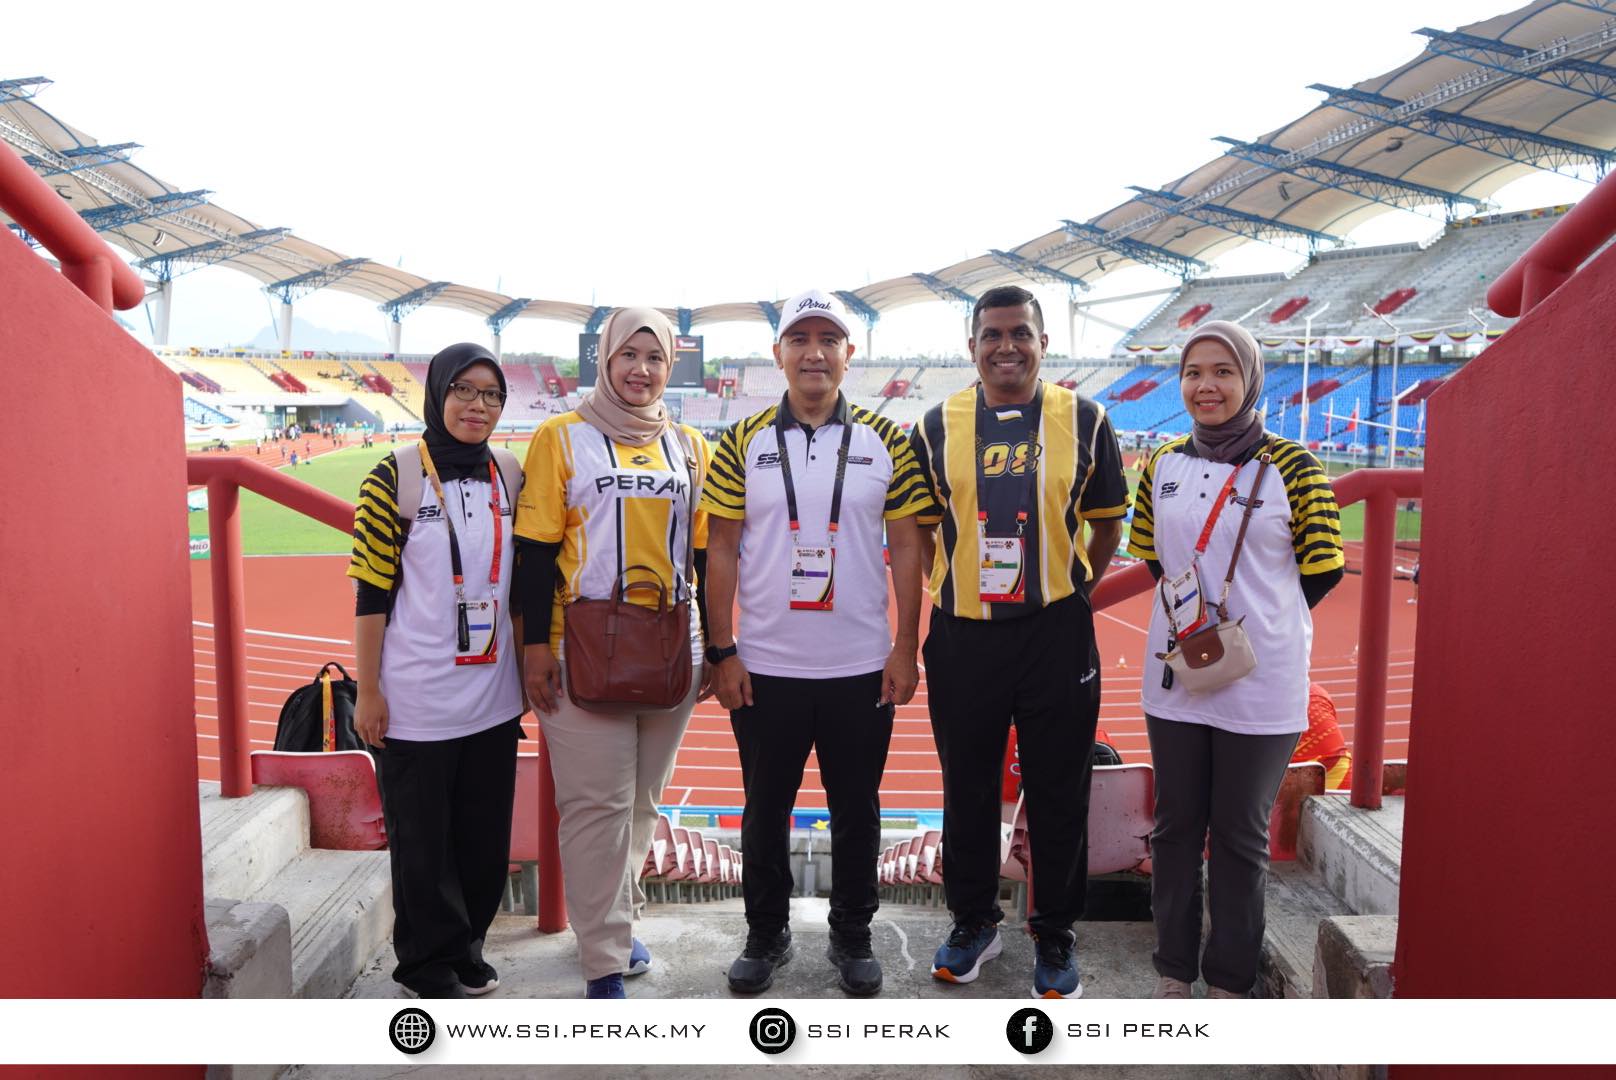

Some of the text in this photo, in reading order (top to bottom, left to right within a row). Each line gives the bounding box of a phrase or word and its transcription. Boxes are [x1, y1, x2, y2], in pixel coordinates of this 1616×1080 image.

[796, 298, 831, 313] Perak
[983, 441, 1043, 477] 08
[595, 474, 688, 502] PERAK
